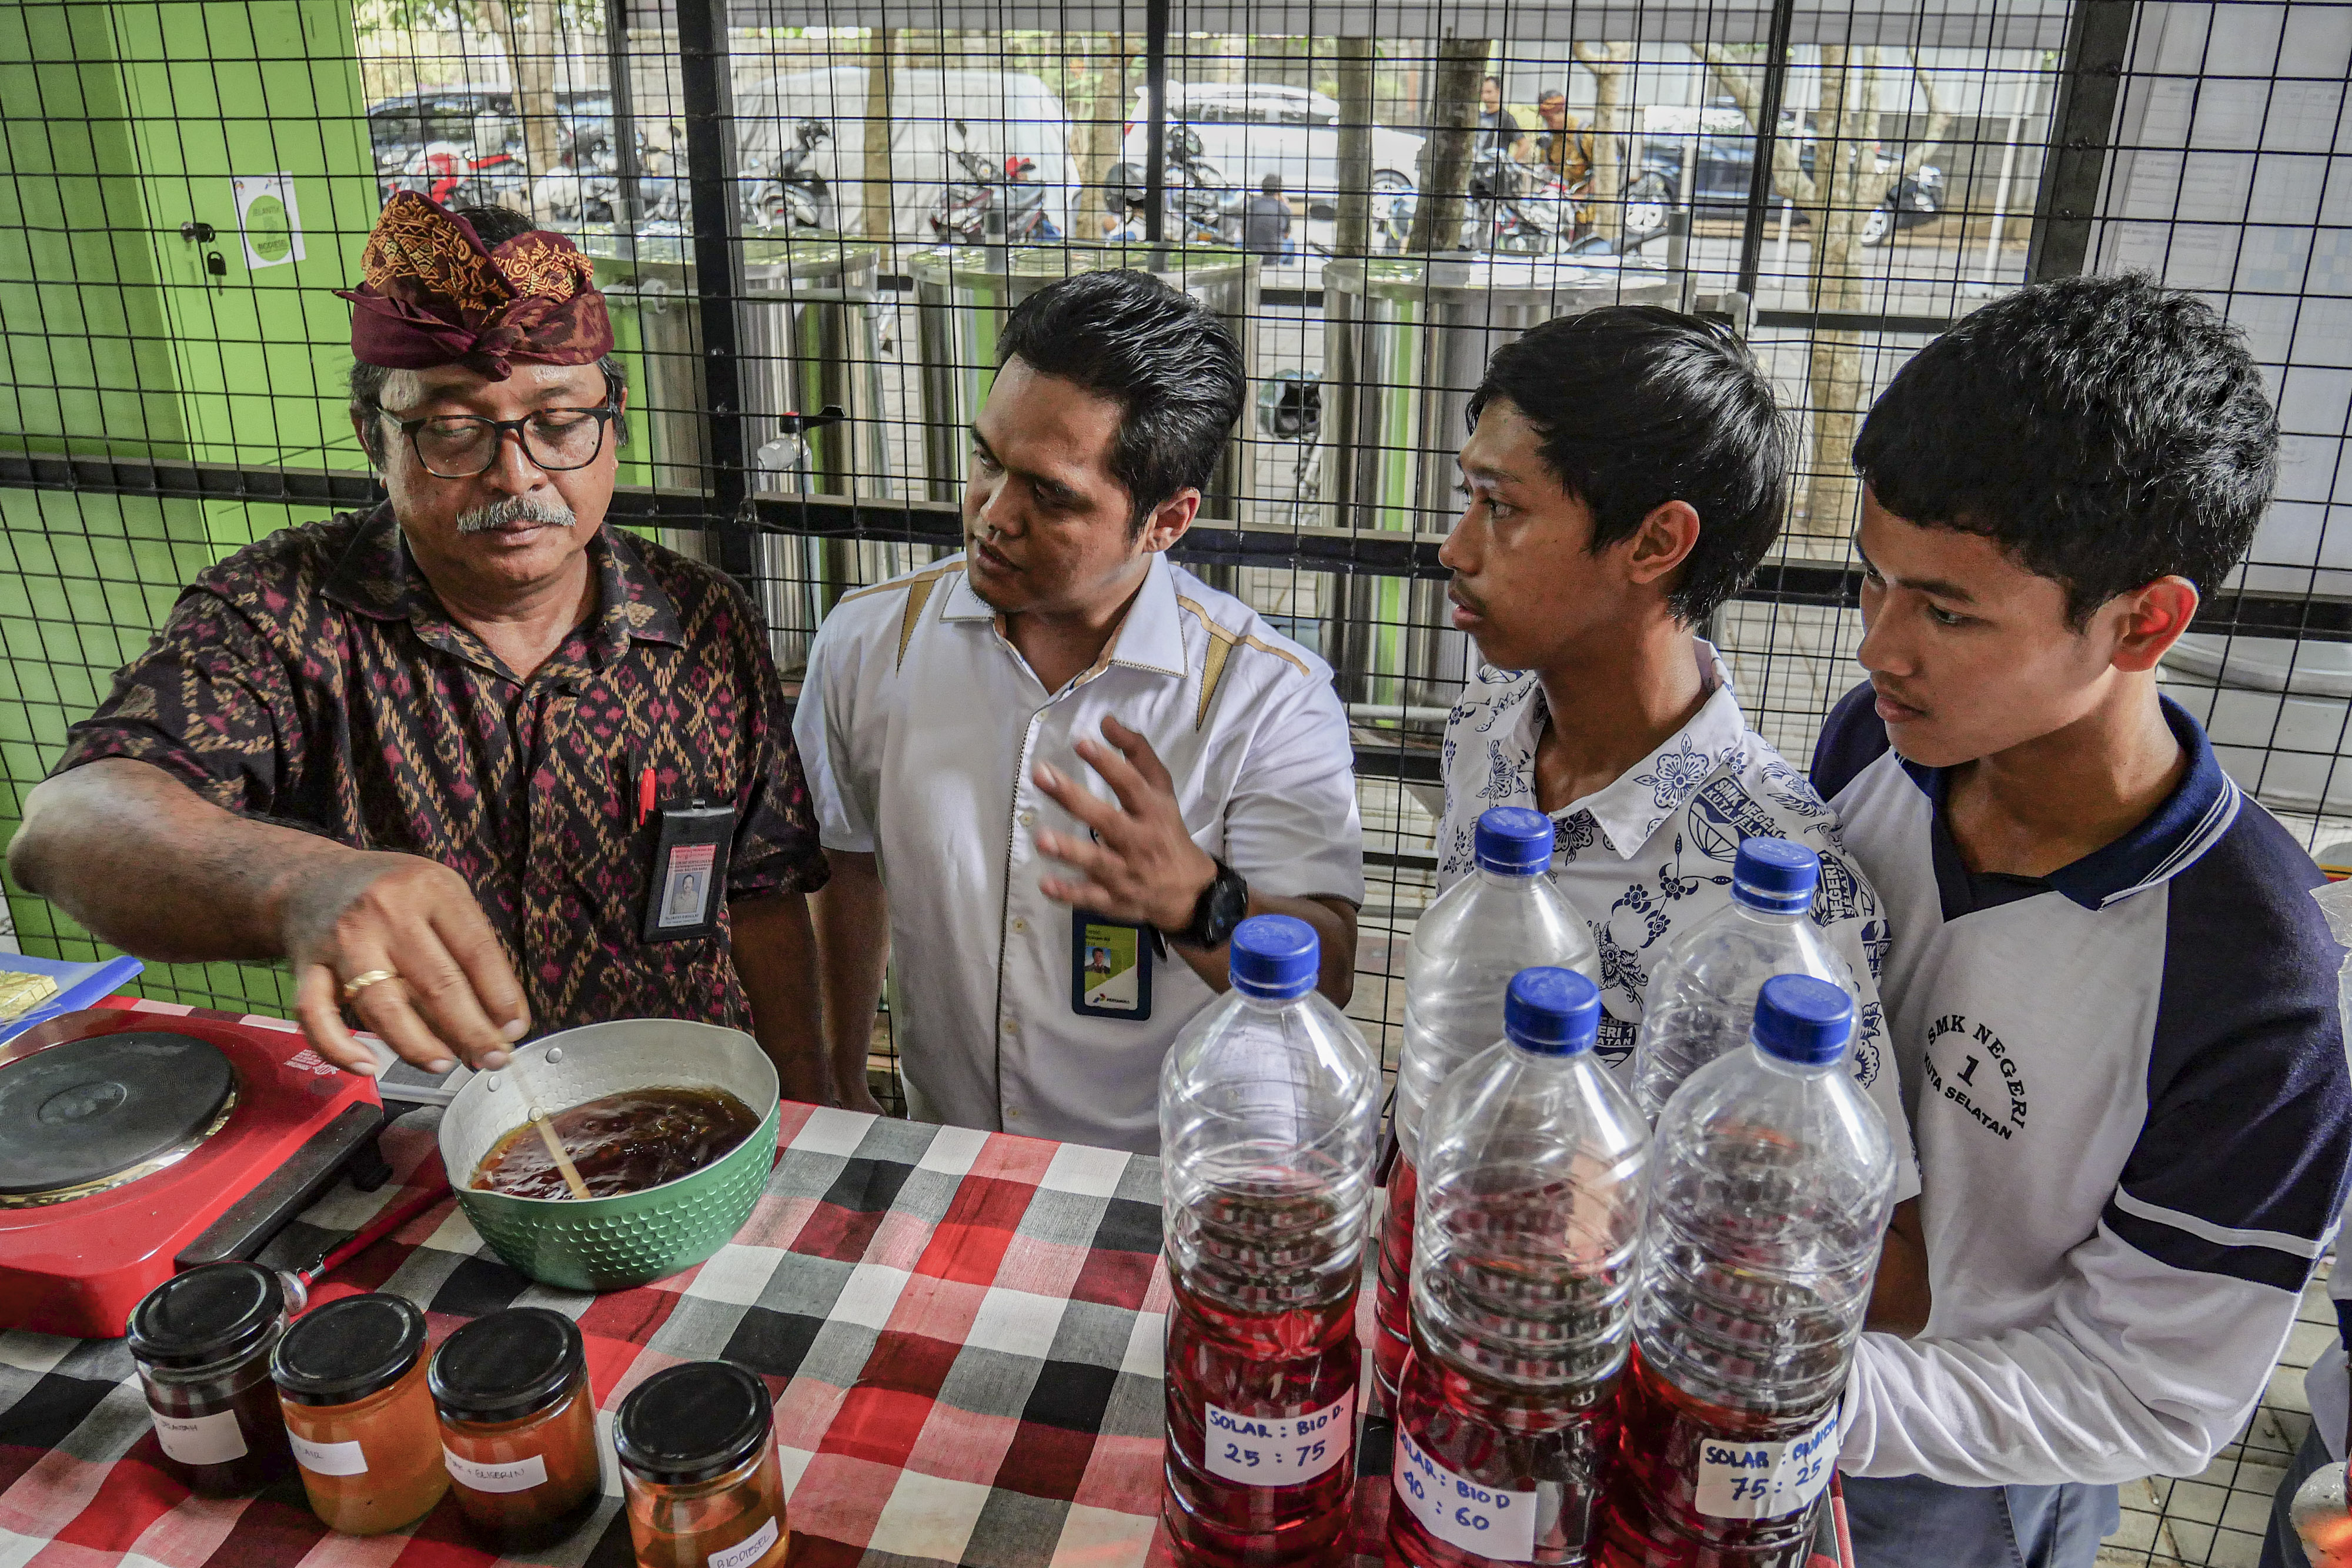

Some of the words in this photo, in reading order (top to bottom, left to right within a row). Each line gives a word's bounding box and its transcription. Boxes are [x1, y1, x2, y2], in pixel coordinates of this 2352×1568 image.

[1706, 790, 1733, 815] KUTA
[1714, 780, 1745, 807] SMK
[1596, 1037, 1631, 1045] ATAN
[1597, 1025, 1622, 1038] ERI
[1626, 1027, 1633, 1037] 1
[1927, 1015, 1965, 1045] SMK
[1973, 1023, 2027, 1129] NEGERI
[1957, 1055, 1979, 1087] 1
[1925, 1052, 1942, 1091] KUTA
[1945, 1086, 2012, 1140] SELATAN
[1210, 1410, 1272, 1438] SOLAR
[1297, 1415, 1328, 1436] BIO
[1224, 1443, 1260, 1467] 25
[1296, 1440, 1325, 1467] 75
[1730, 1477, 1769, 1501] 75
[1795, 1457, 1823, 1486] 25
[1456, 1480, 1491, 1503] BIO
[1495, 1495, 1510, 1509] D
[1455, 1507, 1489, 1530] 60
[717, 1535, 770, 1568] BIODIESEL
